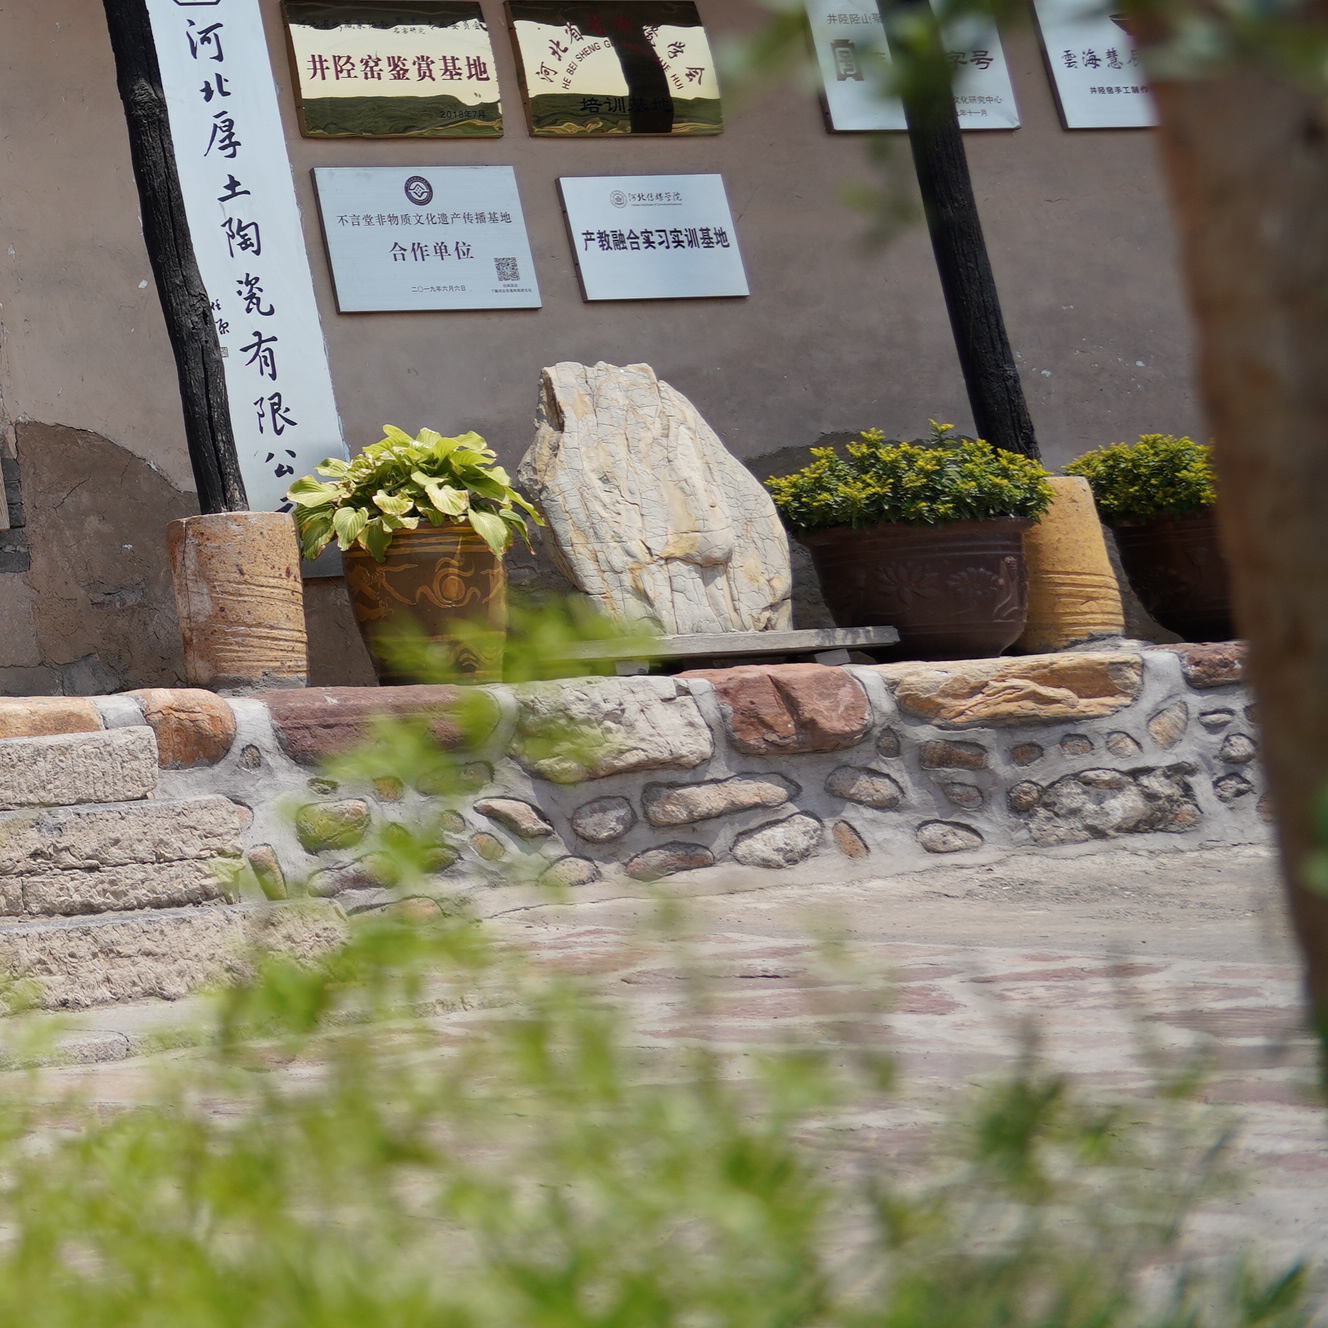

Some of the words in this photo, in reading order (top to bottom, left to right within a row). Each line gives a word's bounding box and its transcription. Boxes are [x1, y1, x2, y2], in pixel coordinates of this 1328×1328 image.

[575, 42, 601, 62] SHENG
[307, 54, 491, 82] 井陉窑鉴赏基地
[566, 61, 578, 76] BEI
[561, 76, 572, 90] HE
[670, 73, 685, 90] HUI
[580, 97, 672, 113] 培训基地
[336, 211, 513, 227] 不言堂非物质文化遗产传播基地
[582, 227, 730, 251] 产教融合实习实训基地
[389, 241, 475, 262] 合作单位
[186, 19, 297, 514] 河北厚土陶瓷有限公
